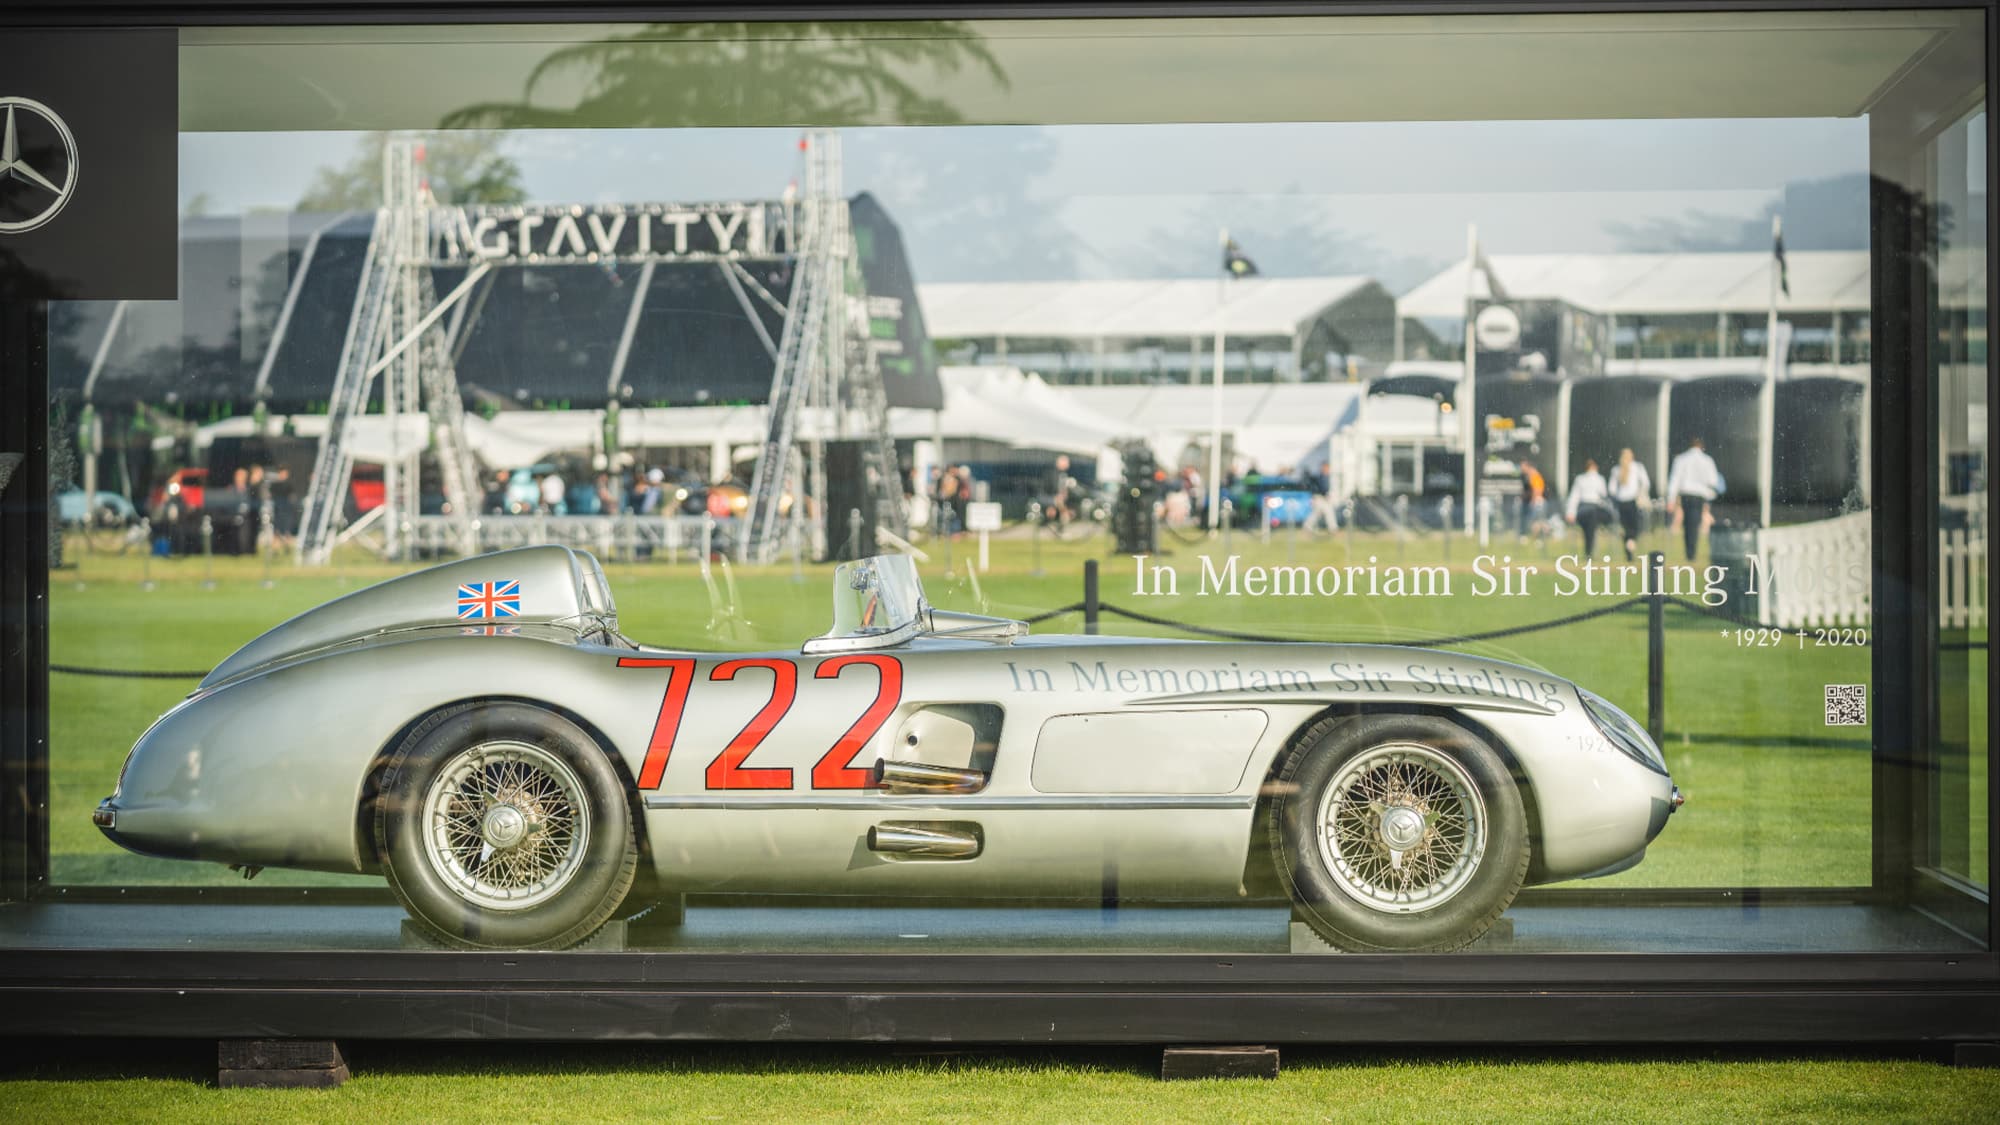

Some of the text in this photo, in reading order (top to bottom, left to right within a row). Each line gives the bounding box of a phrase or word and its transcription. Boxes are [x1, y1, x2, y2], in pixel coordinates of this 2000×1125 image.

[1131, 554, 1181, 597] In
[1196, 554, 1455, 597] Memoriam
[1471, 554, 1538, 597] Sir
[1554, 554, 1729, 607] Stirling
[1003, 660, 1567, 713] In Memoriam Sir Stirling
[615, 653, 903, 791] 722
